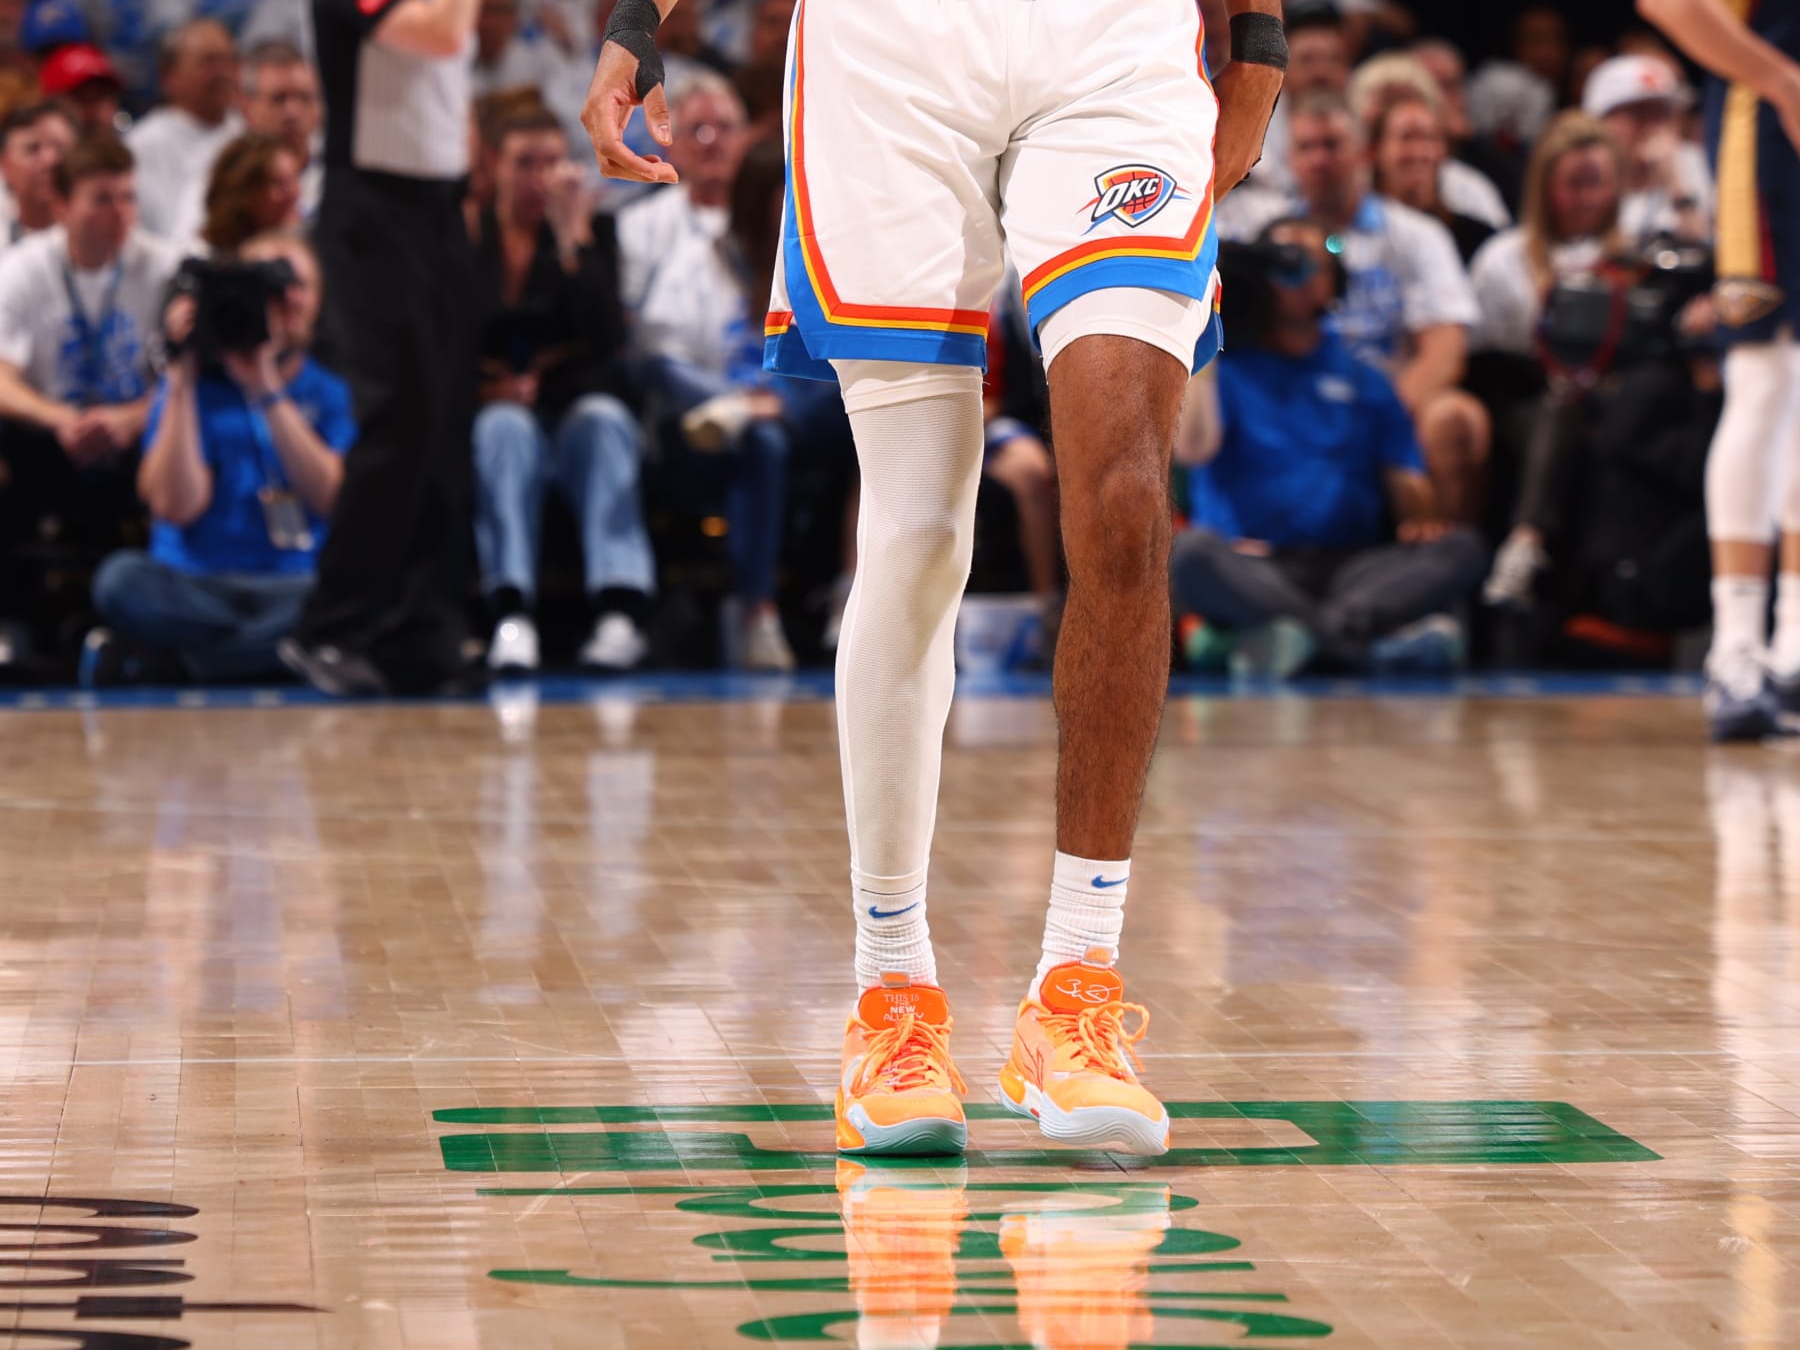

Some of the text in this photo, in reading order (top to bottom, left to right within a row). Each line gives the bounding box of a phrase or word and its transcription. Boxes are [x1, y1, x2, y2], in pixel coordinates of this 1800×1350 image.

[1091, 177, 1161, 221] OKC
[883, 993, 908, 1002] THIS
[890, 1005, 916, 1013] NEW
